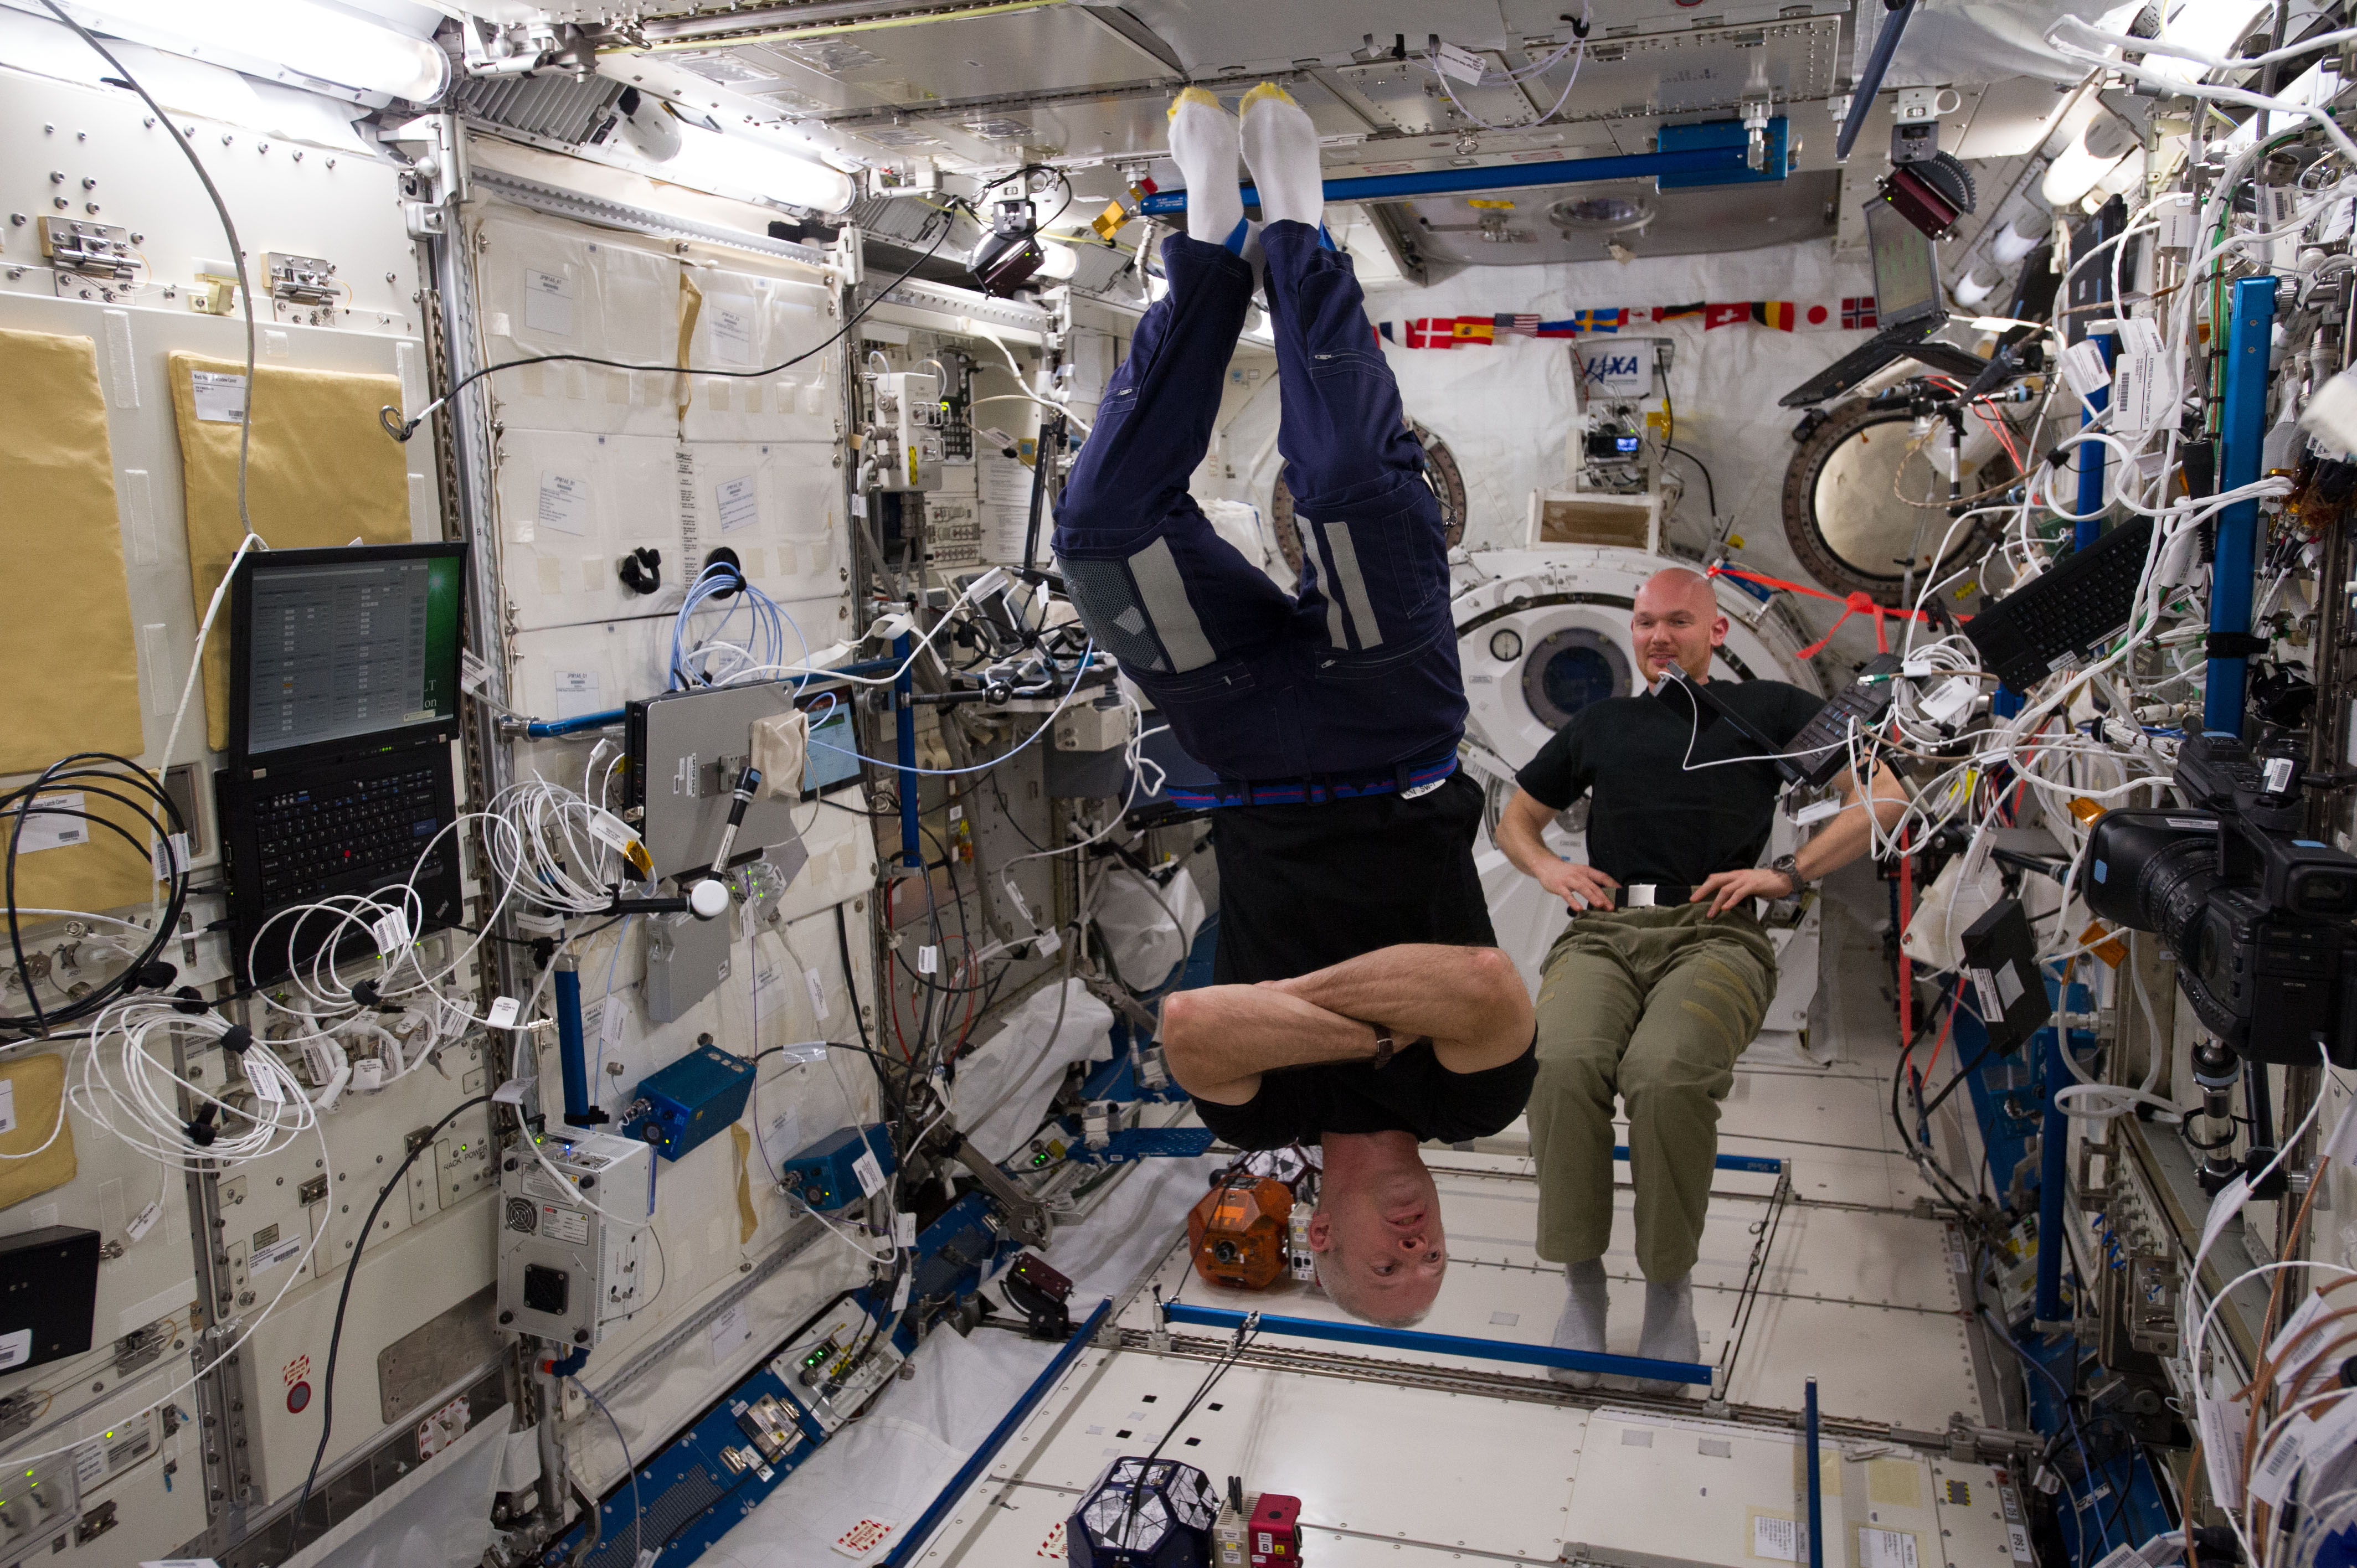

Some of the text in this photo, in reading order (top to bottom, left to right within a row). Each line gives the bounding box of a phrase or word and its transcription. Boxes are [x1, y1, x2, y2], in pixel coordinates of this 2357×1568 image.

[1586, 354, 1637, 384] JAXA
[1421, 782, 1436, 793] SW-1
[444, 1144, 488, 1170] RACK POWER
[745, 1452, 755, 1462] A
